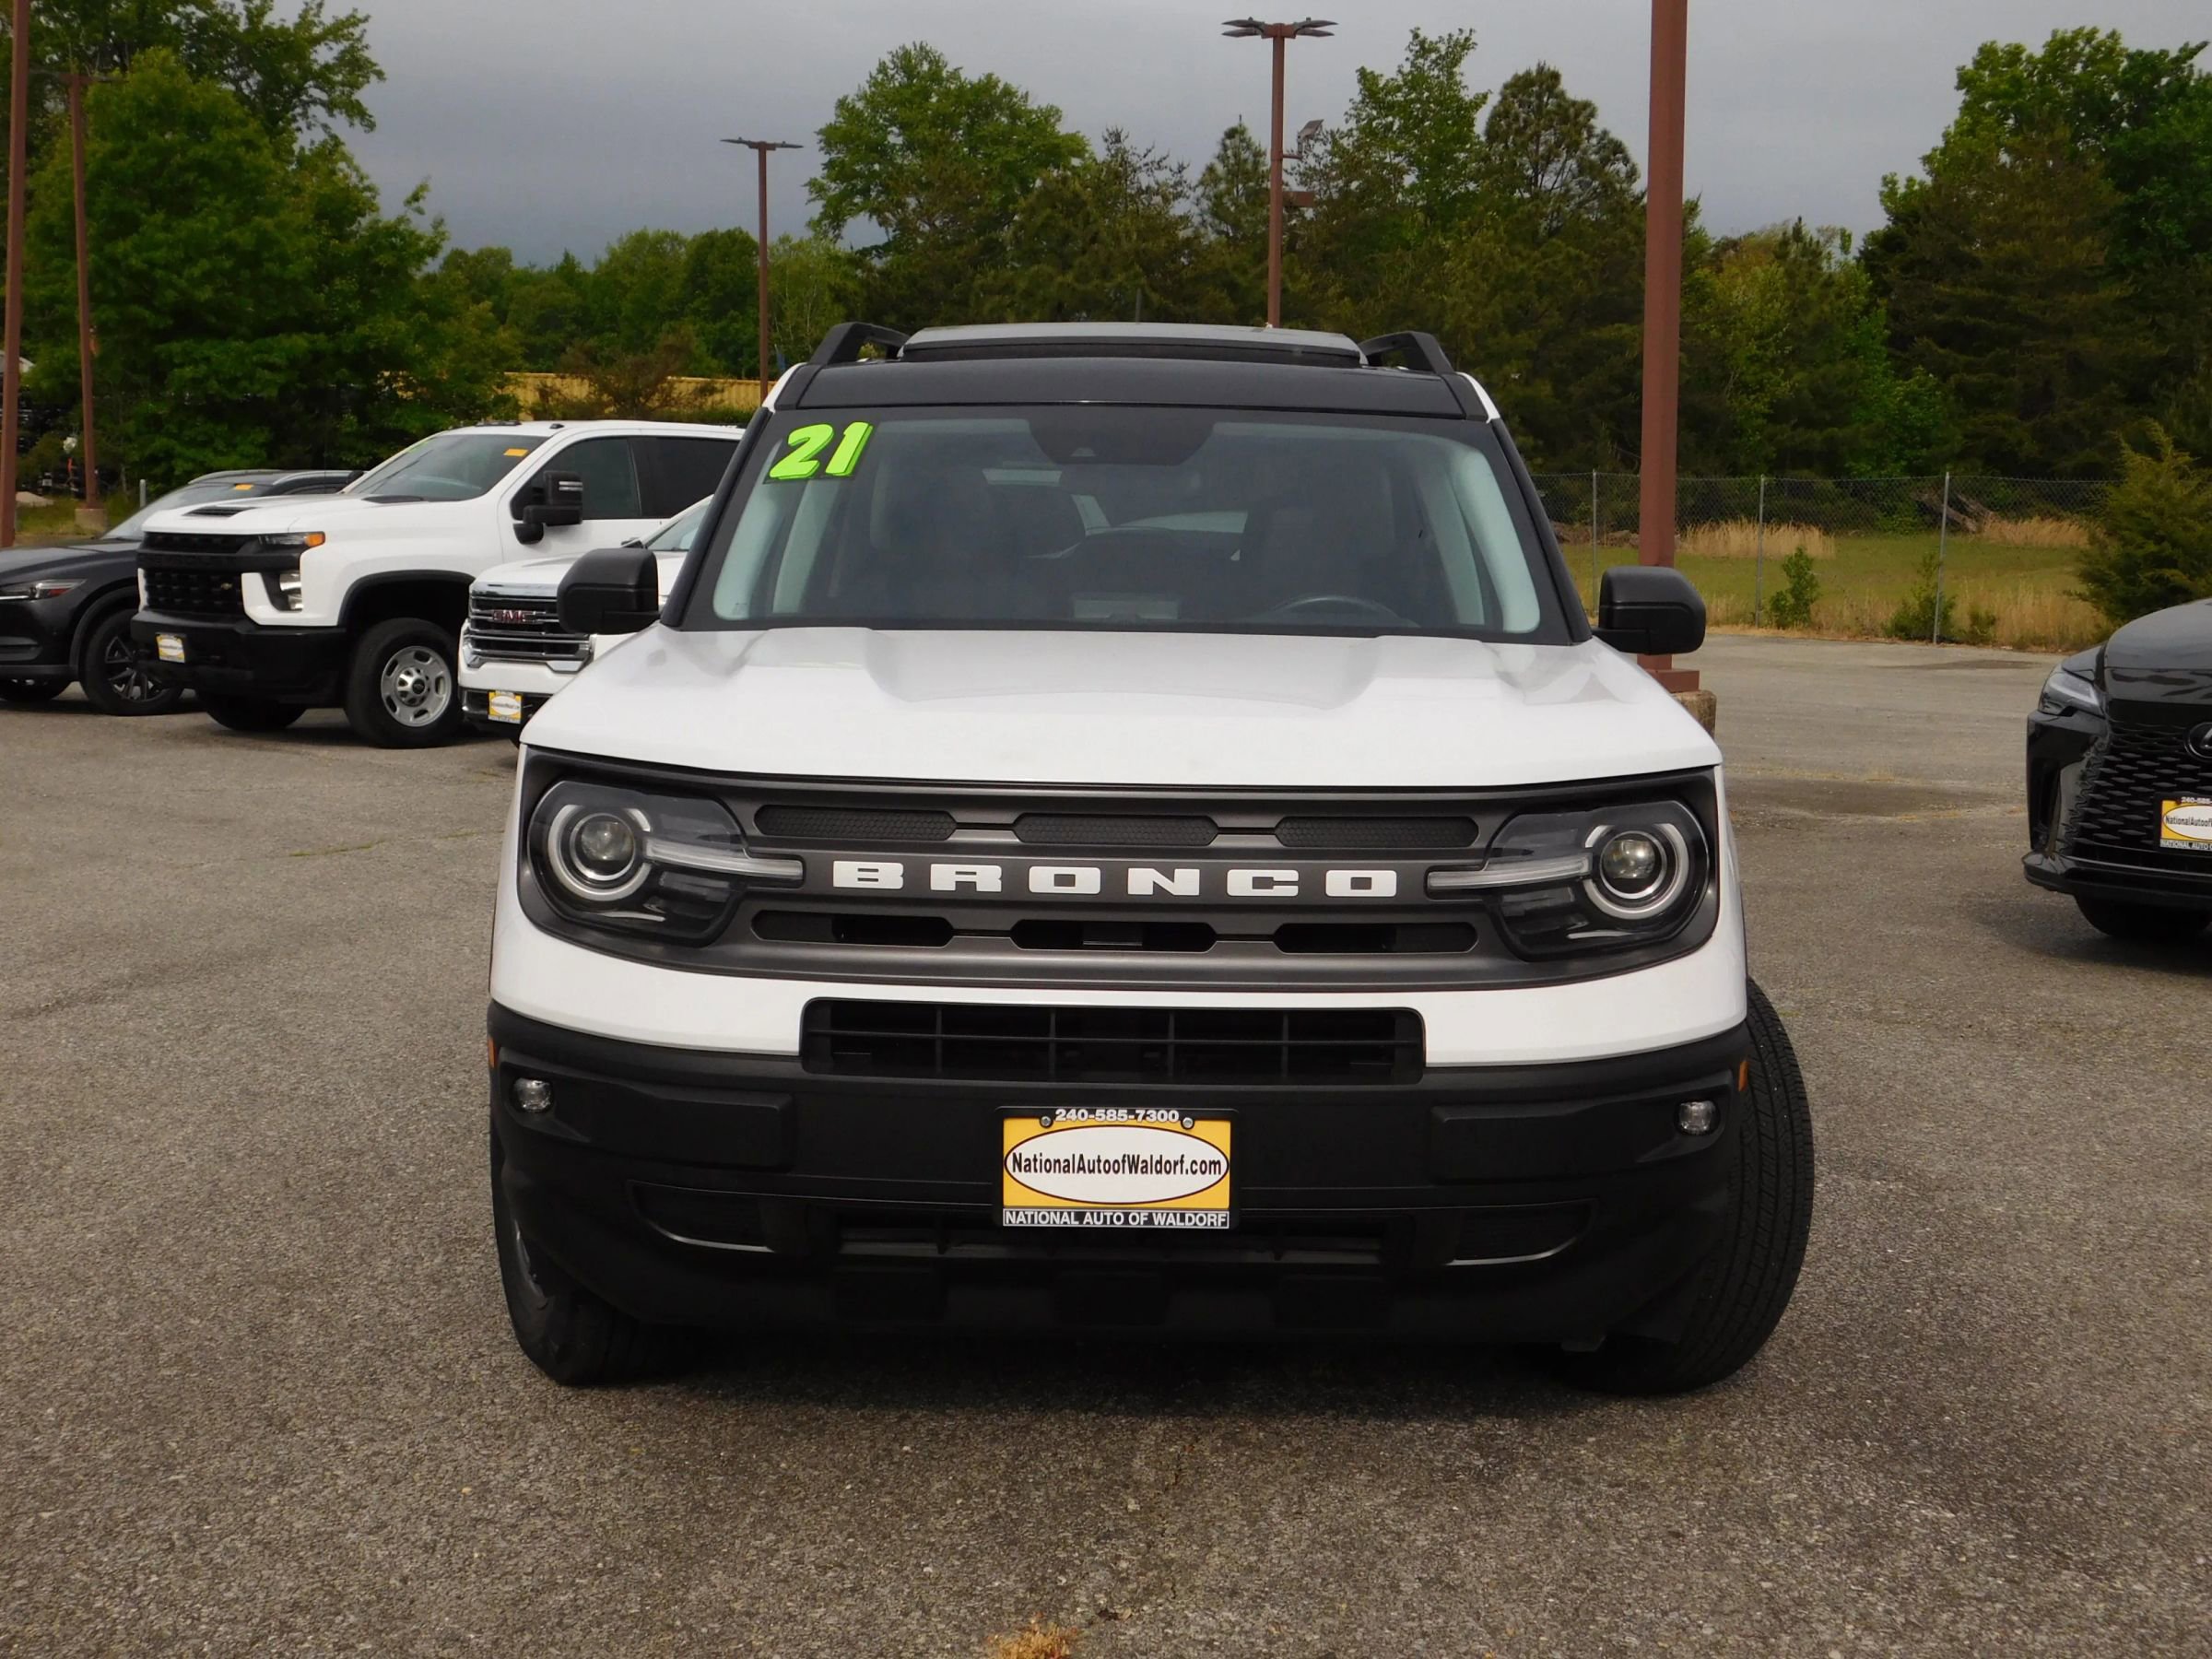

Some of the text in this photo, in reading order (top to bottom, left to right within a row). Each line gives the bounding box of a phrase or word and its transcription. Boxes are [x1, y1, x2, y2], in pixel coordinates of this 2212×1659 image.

[769, 420, 874, 480] 21
[833, 860, 1397, 897] BRONCO
[1054, 1108, 1180, 1123] 240-585-7300
[1012, 1152, 1222, 1175] NationalAutoofWaldorf.com
[1005, 1210, 1228, 1227] NATIONAL AUTO OF WALDORF
